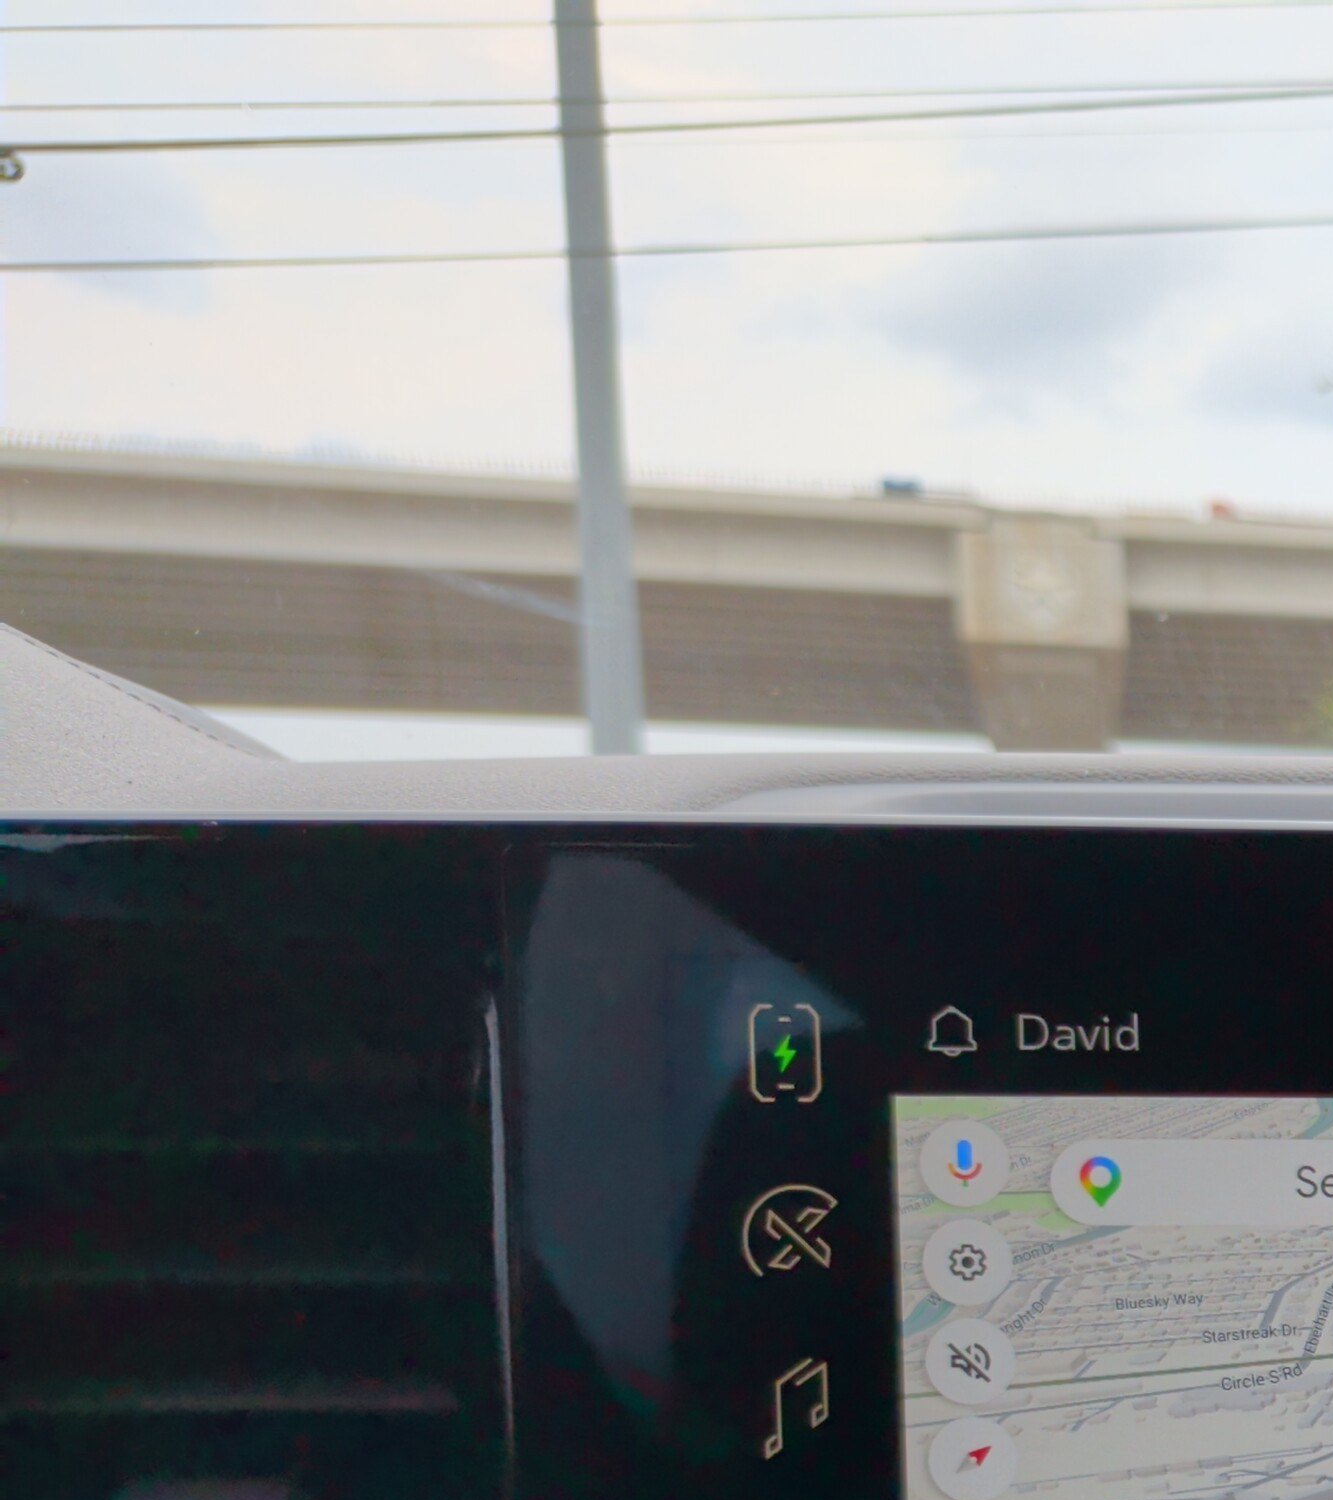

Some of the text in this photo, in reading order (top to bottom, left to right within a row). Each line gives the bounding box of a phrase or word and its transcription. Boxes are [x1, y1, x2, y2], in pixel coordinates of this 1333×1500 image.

[1016, 1013, 1141, 1053] David
[1031, 1298, 1048, 1314] Dr
[1115, 1293, 1204, 1311] Bluesky Way
[1202, 1323, 1298, 1344] Starstreak Dr
[1304, 1301, 1333, 1354] Eberhart
[1220, 1363, 1304, 1392] Circle S Rd
